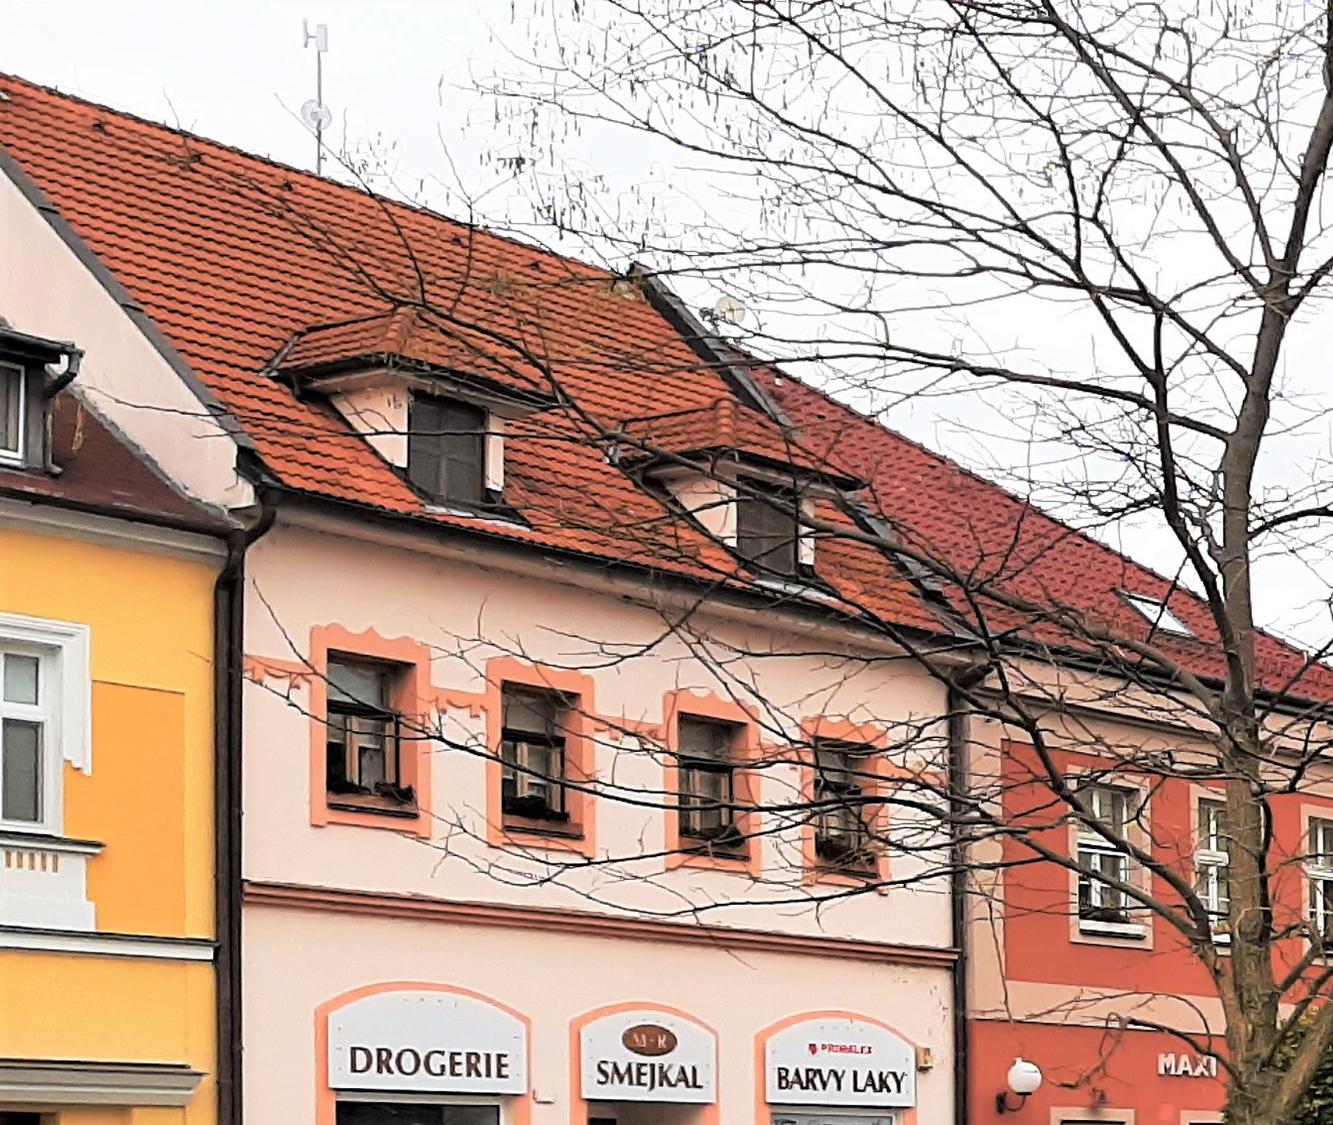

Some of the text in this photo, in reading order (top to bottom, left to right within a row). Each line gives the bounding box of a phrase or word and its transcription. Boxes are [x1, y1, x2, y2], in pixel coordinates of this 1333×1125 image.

[349, 1046, 510, 1079] DROGERIE
[596, 1060, 704, 1091] SMEJKAL
[1158, 1053, 1217, 1077] MAXI
[777, 1066, 905, 1093] BARVY LAKY
